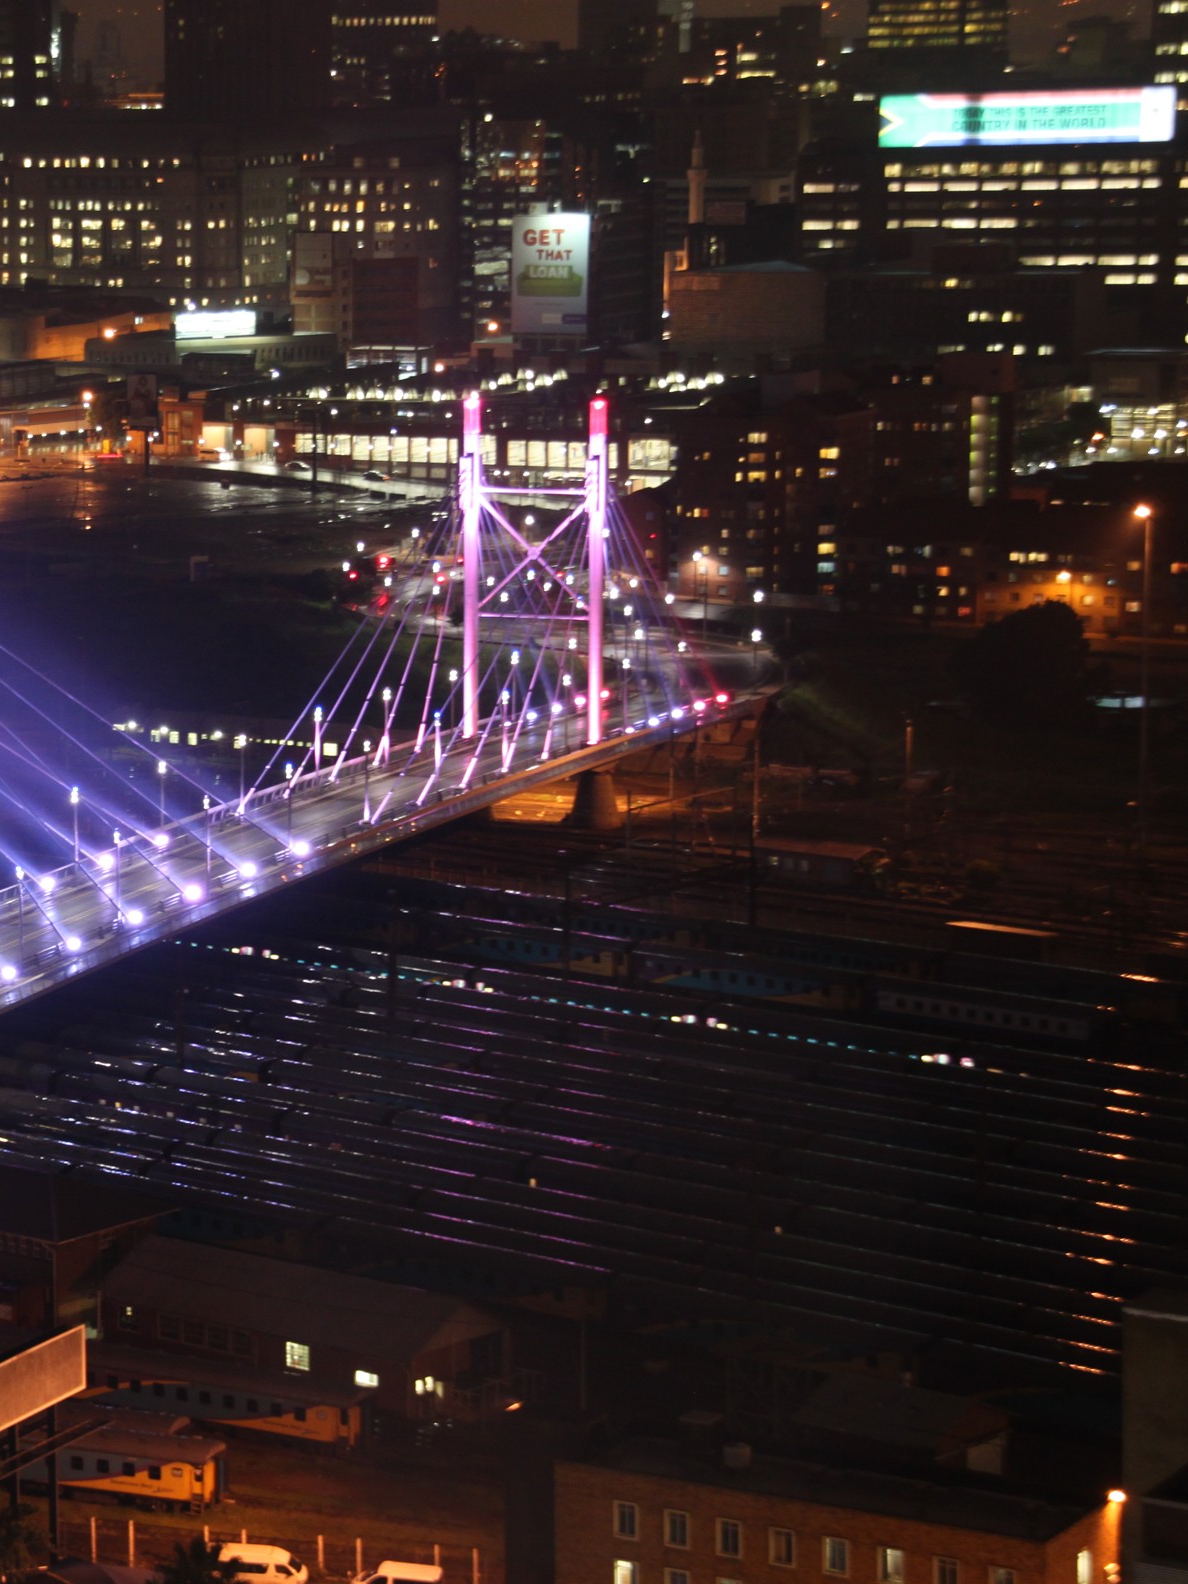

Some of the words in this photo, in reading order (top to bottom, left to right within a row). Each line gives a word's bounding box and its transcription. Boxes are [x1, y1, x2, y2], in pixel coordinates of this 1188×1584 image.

[990, 107, 1012, 118] THIS
[1016, 107, 1026, 117] IS
[1030, 106, 1049, 117] THE
[1053, 105, 1107, 116] GREATEST
[952, 120, 1010, 132] COUNTRY
[1017, 119, 1027, 130] IN
[1032, 119, 1055, 130] THE
[1059, 118, 1107, 129] WORLD
[523, 229, 564, 246] GET
[536, 249, 572, 261] THAT
[529, 266, 569, 279] LOAN
